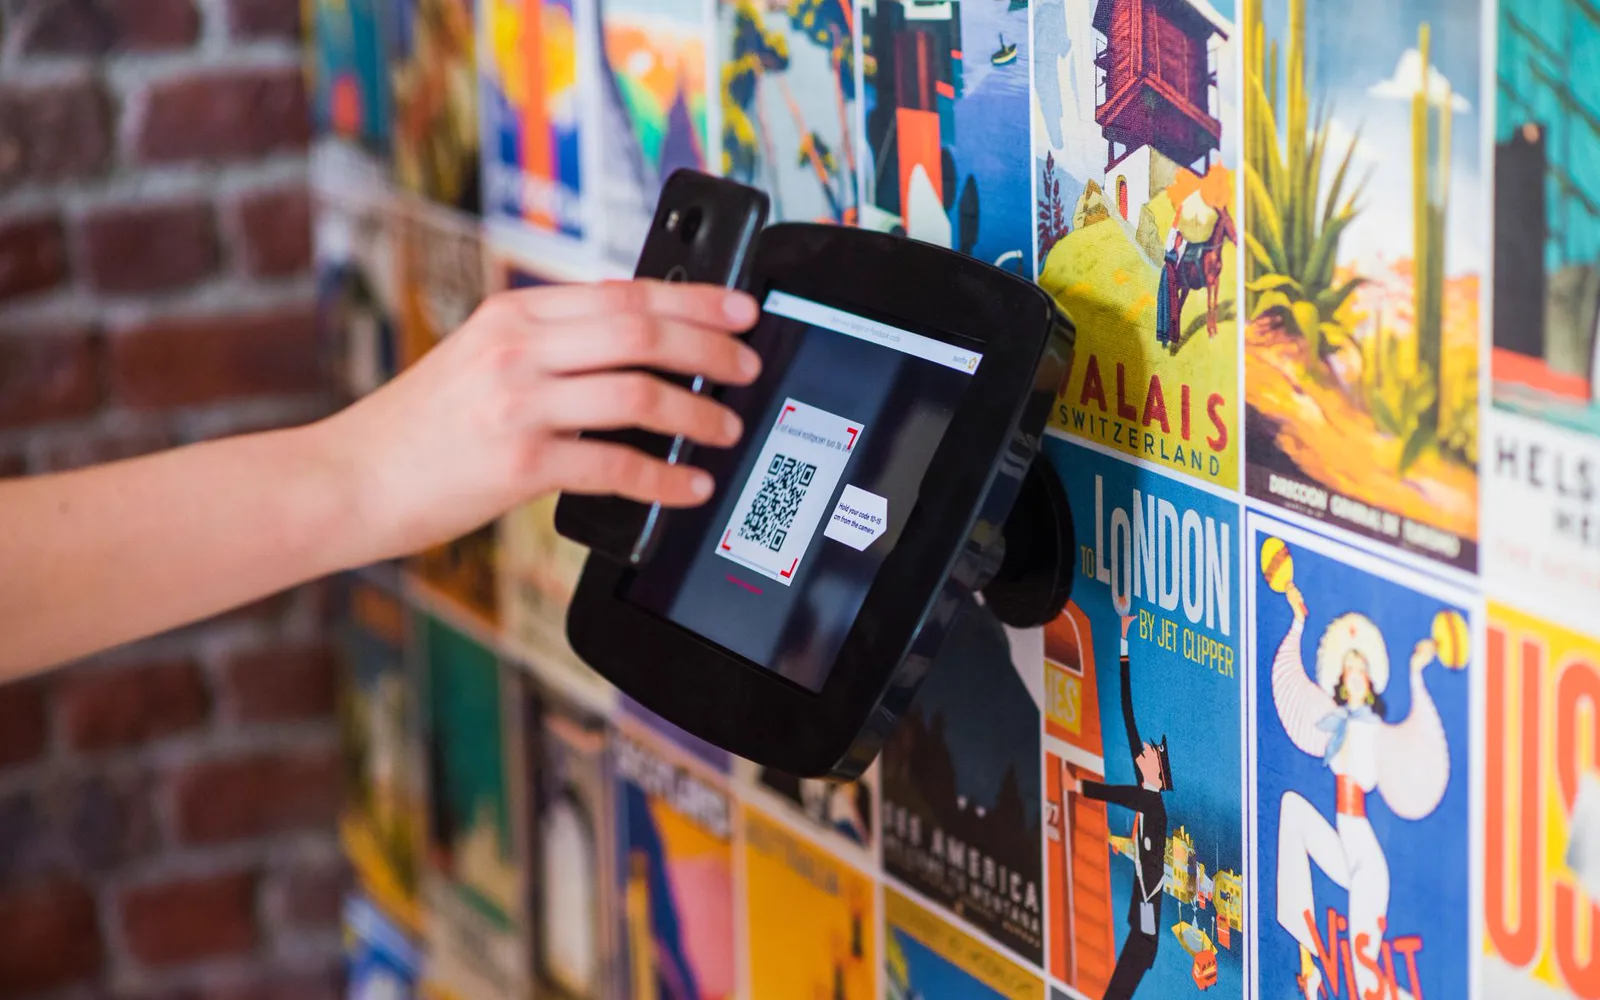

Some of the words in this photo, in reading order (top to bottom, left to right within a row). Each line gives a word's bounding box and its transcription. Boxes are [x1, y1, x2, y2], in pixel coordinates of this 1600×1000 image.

[1060, 404, 1220, 476] SWITZERLAND
[838, 502, 849, 512] Hold
[848, 508, 859, 516] your
[859, 511, 870, 520] code
[840, 515, 851, 525] from
[851, 520, 859, 528] the
[858, 524, 875, 535] camera
[1080, 545, 1095, 579] TO
[1095, 474, 1230, 637] LONDON
[1139, 609, 1156, 642] BY
[1157, 618, 1178, 653] JET
[1183, 628, 1234, 678] CLIPPER
[931, 827, 1039, 914] AMERICA
